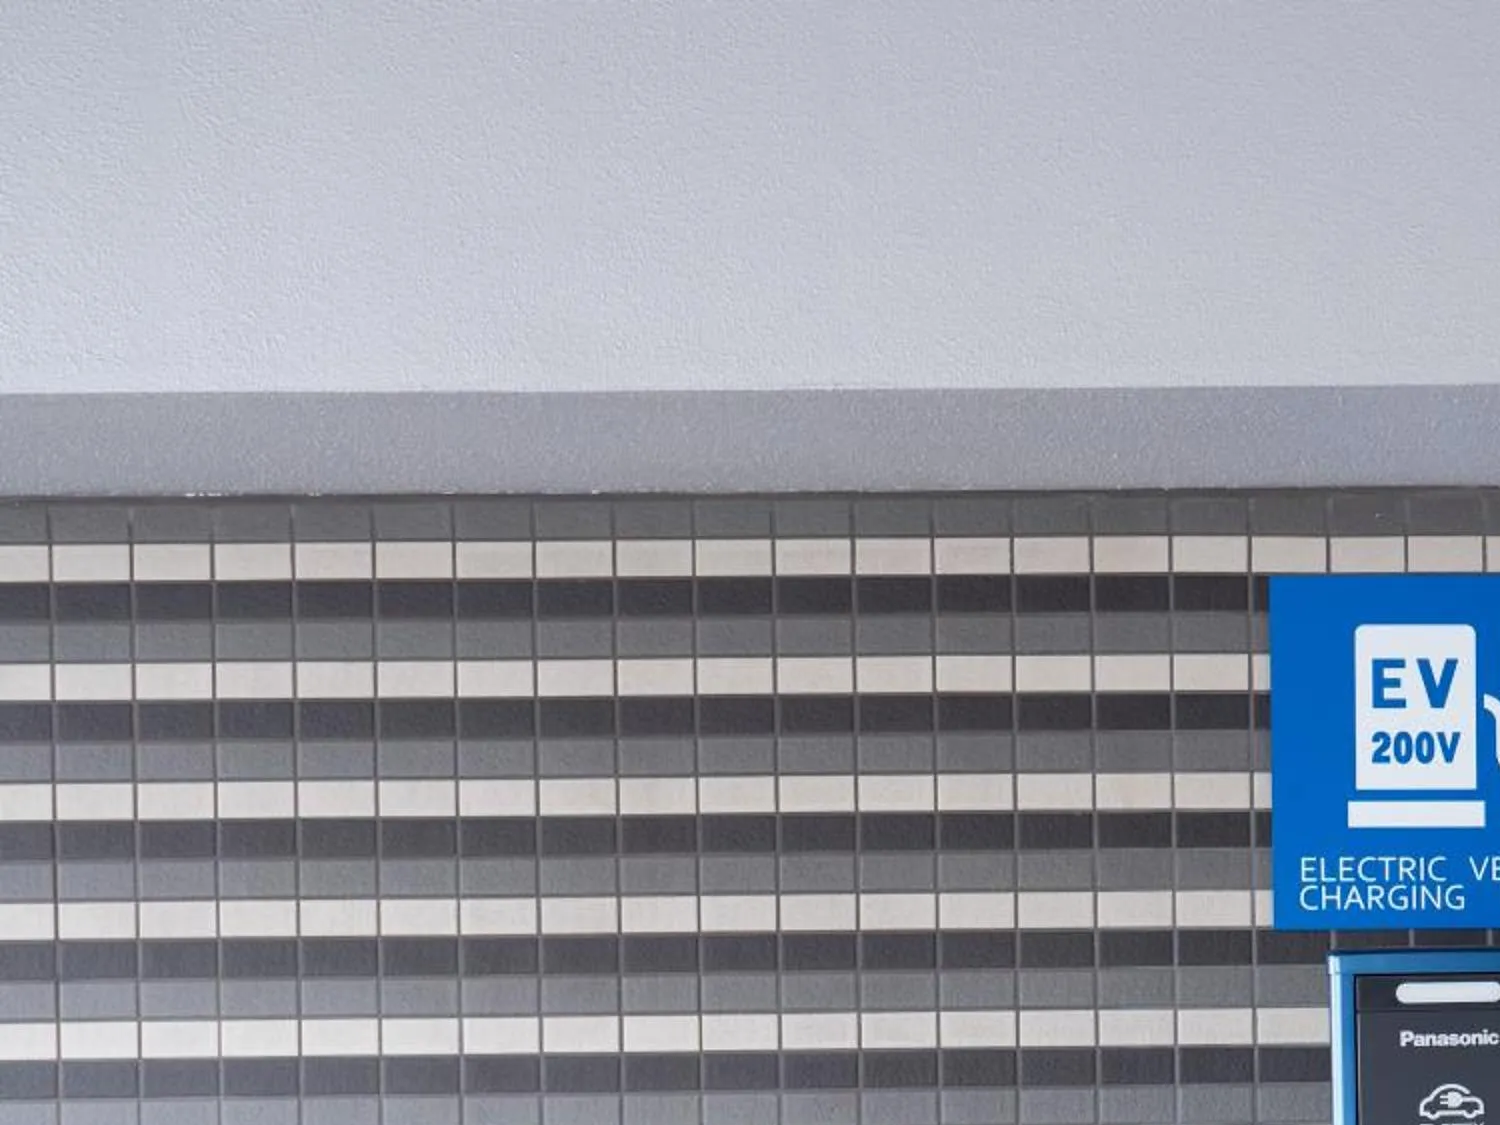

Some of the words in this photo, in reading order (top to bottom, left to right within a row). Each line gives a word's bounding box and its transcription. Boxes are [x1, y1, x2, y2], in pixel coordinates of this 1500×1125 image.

[1371, 658, 1459, 709] EV
[1371, 730, 1462, 765] 200V
[1299, 856, 1448, 883] ELECTRIC
[1298, 884, 1466, 911] CHARGING
[1399, 1028, 1500, 1048] Panasonic
